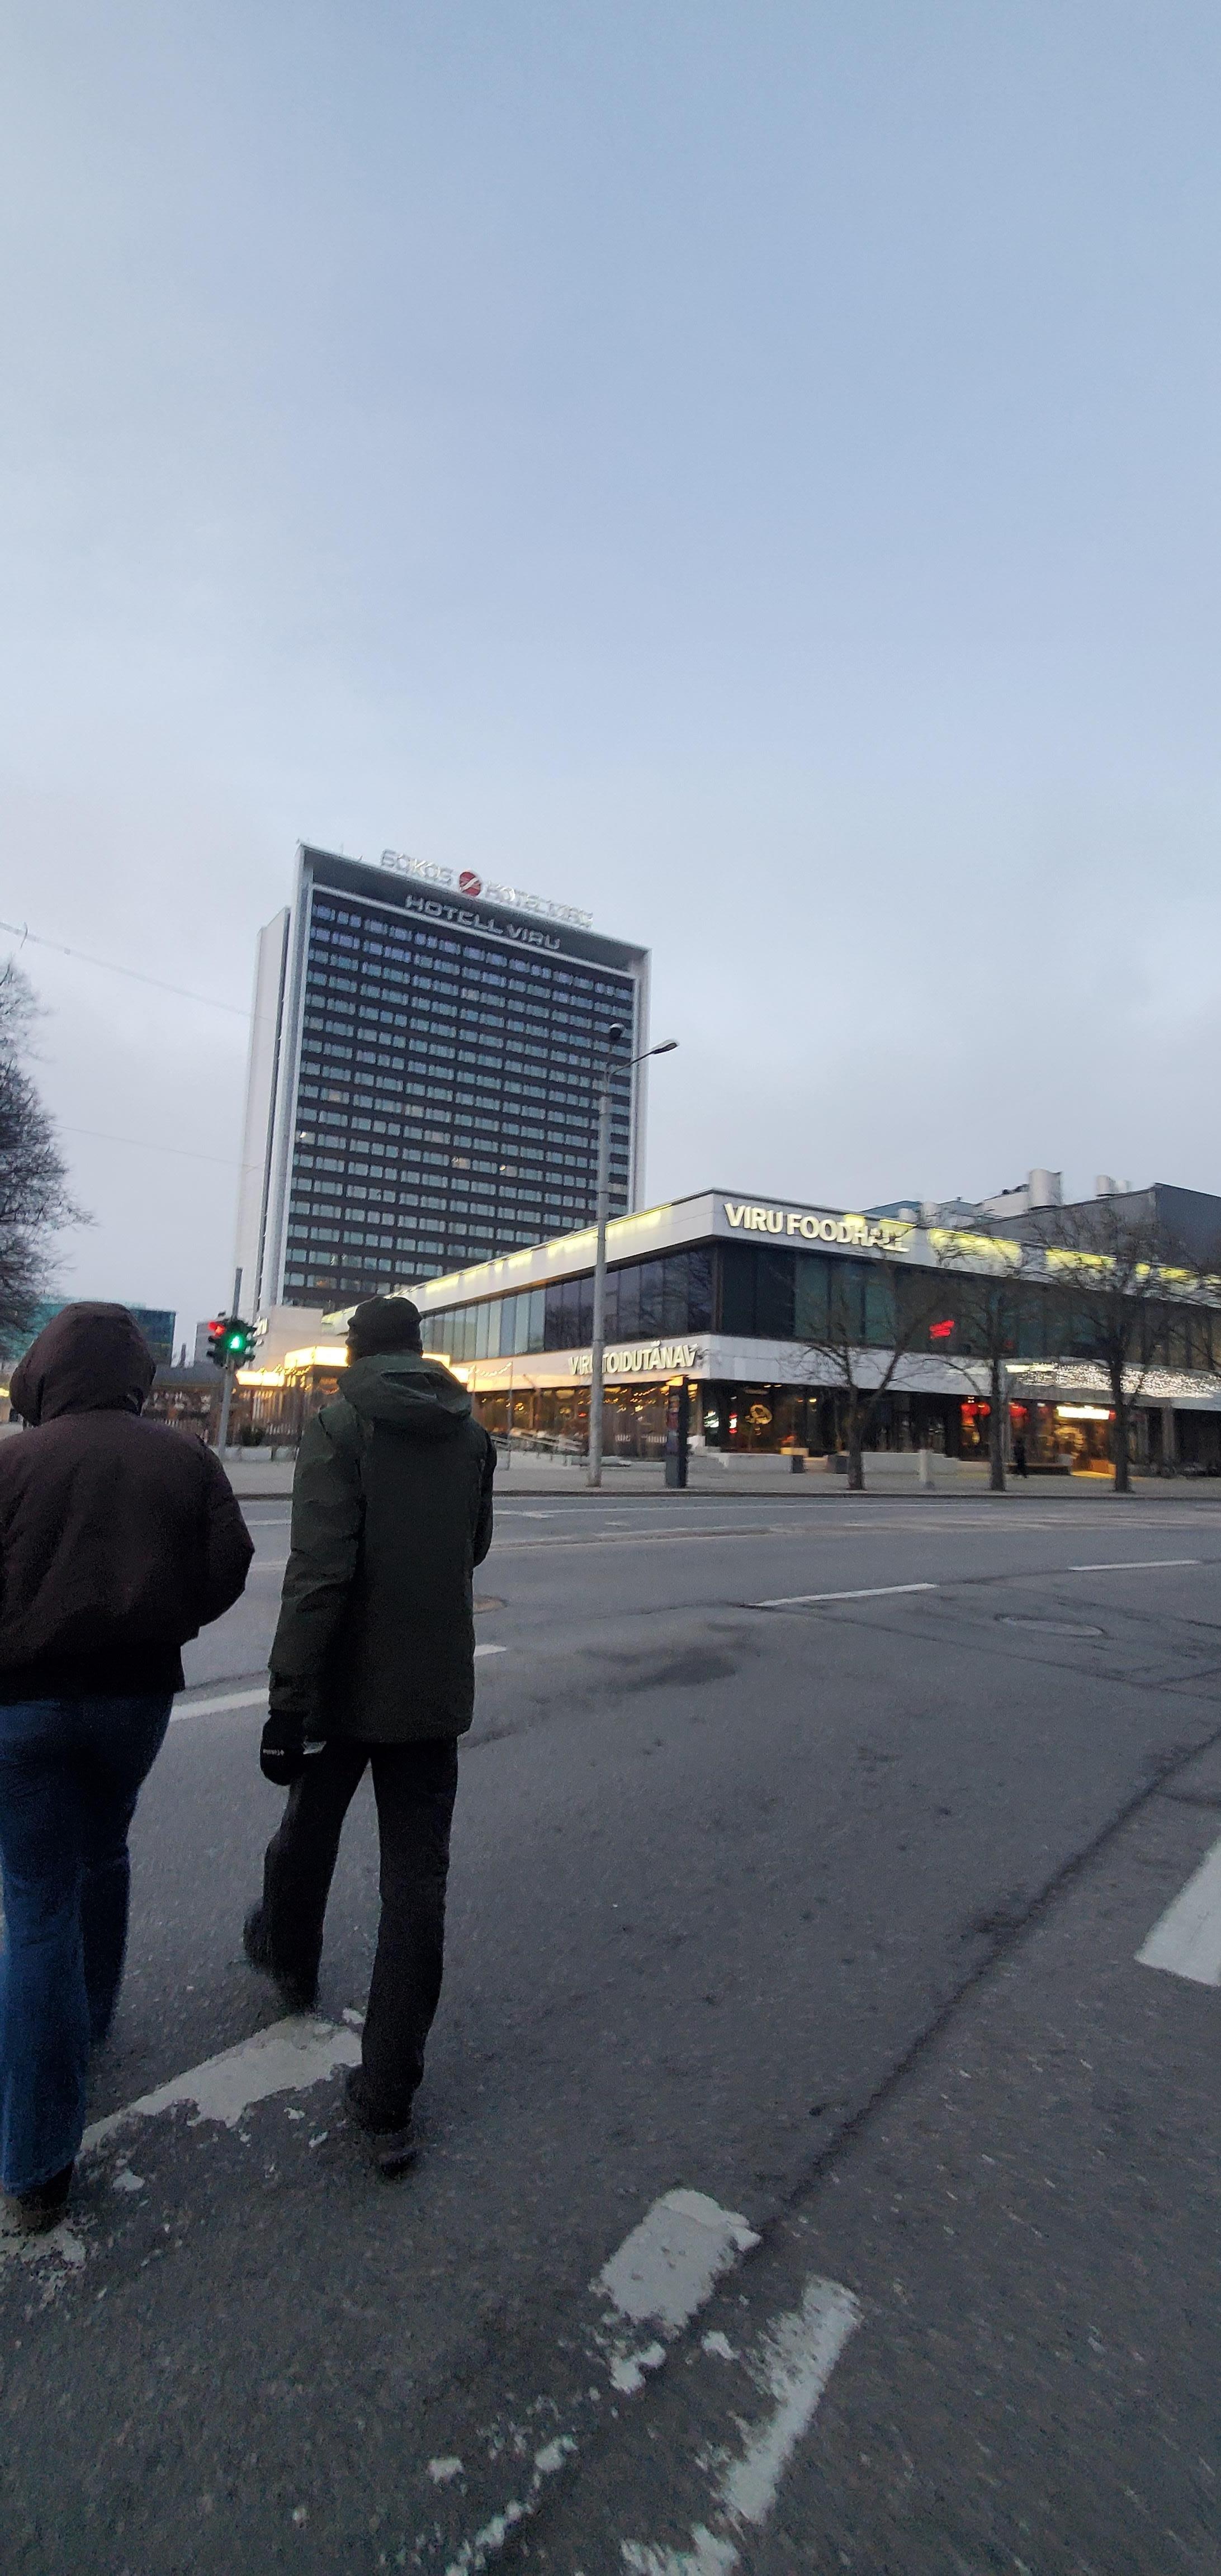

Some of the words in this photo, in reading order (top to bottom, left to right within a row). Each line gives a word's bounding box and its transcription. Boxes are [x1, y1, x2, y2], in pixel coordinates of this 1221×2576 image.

[405, 894, 503, 934] HOTELL
[506, 923, 561, 949] VIRU
[725, 1202, 783, 1234] VIRU
